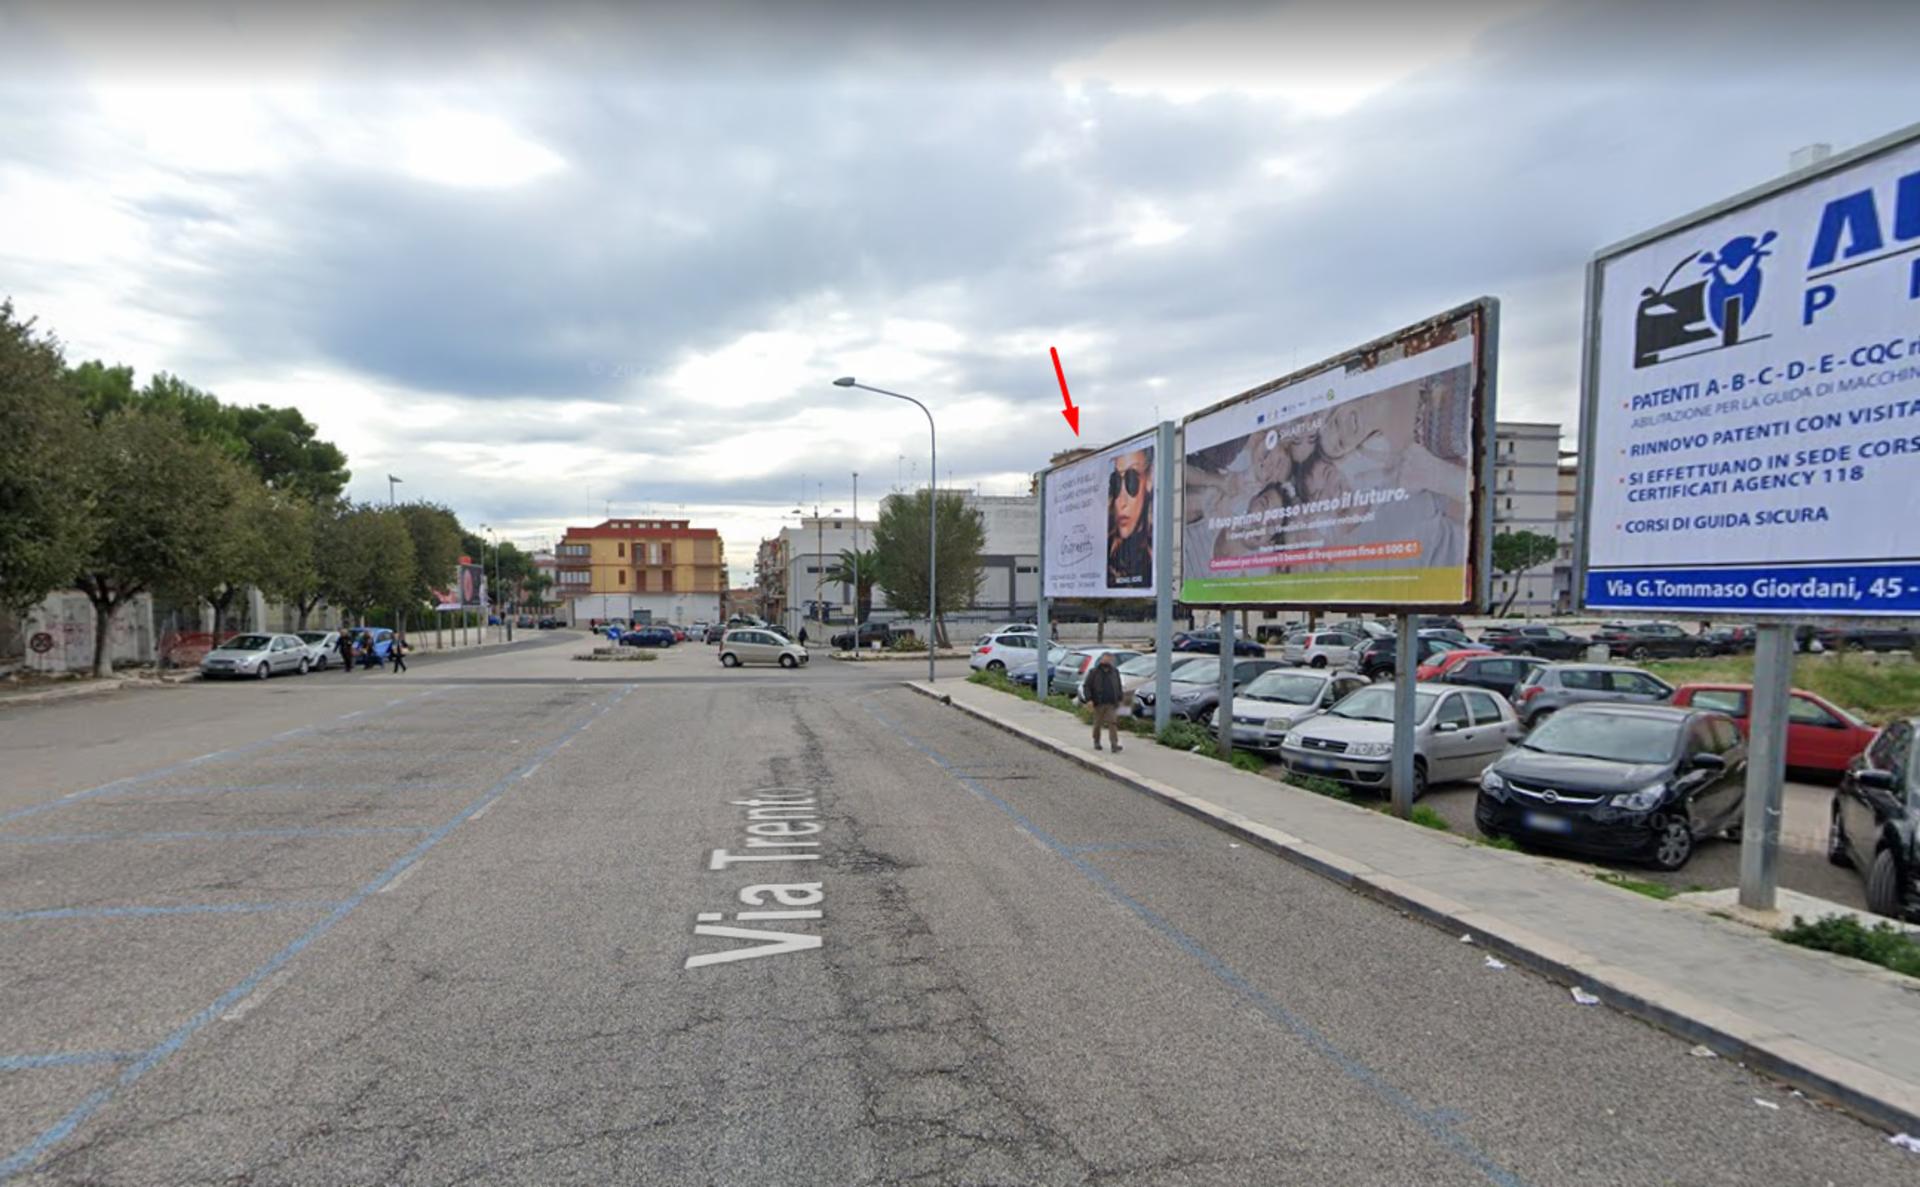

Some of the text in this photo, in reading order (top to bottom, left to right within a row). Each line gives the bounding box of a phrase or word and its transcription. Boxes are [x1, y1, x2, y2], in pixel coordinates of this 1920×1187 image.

[1631, 404, 1712, 428] ABILITAZIONE
[1715, 400, 1739, 414] PER
[1742, 397, 1759, 410] LA
[1763, 386, 1812, 406] GUIDA
[1816, 382, 1834, 397] DI
[1632, 383, 1699, 411] PATENTI
[1631, 399, 1920, 457] RINNOVO PATENTI CON VISITA
[1629, 435, 1920, 485] SI EFFETTUANO IN SEDE CORS
[1627, 465, 1864, 502] CERTIFICATI AGENCY 118
[1231, 511, 1263, 531] primo
[1263, 503, 1300, 526] passo
[1302, 497, 1340, 515] verso
[1341, 491, 1352, 508] il
[1353, 487, 1410, 507] futuro.
[1625, 506, 1829, 533] CORSI DI GUIDA SICURA
[1606, 579, 1632, 596] Via
[1752, 577, 1862, 600] Giordani,
[1869, 577, 1903, 598] 45
